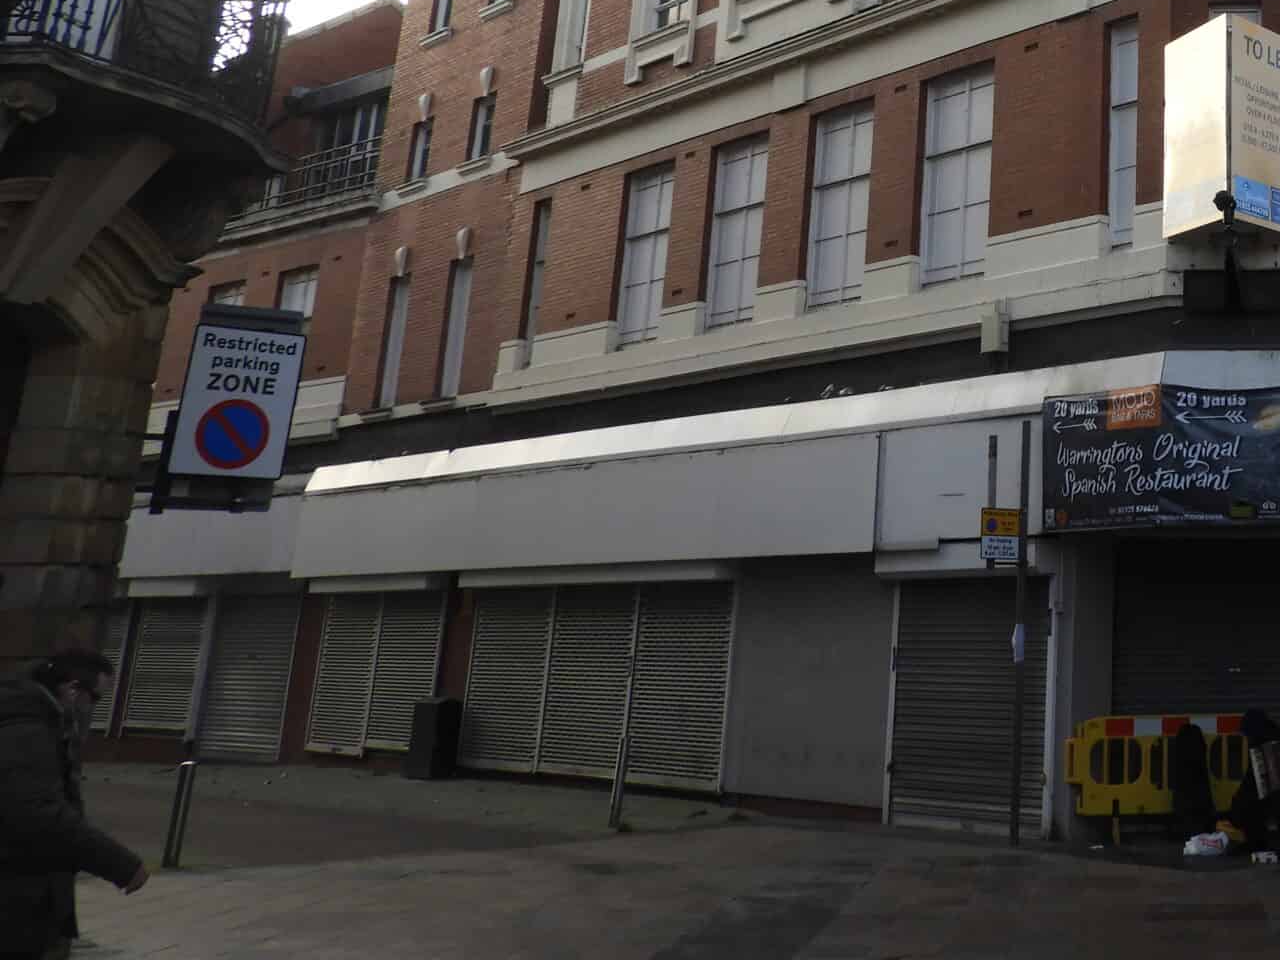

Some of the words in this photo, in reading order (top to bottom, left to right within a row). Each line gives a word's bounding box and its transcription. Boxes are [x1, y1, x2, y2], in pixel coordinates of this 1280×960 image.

[1243, 35, 1263, 60] TO
[202, 332, 297, 356] Restricted
[211, 354, 280, 375] parking
[206, 372, 277, 396] ZONE
[1054, 400, 1068, 418] 20
[1069, 398, 1099, 419] yards
[1176, 391, 1198, 408] 20
[1202, 392, 1247, 409] yards
[1152, 432, 1241, 473] Original
[1061, 467, 1117, 504] Spanish
[1123, 464, 1244, 496] Restaurant
